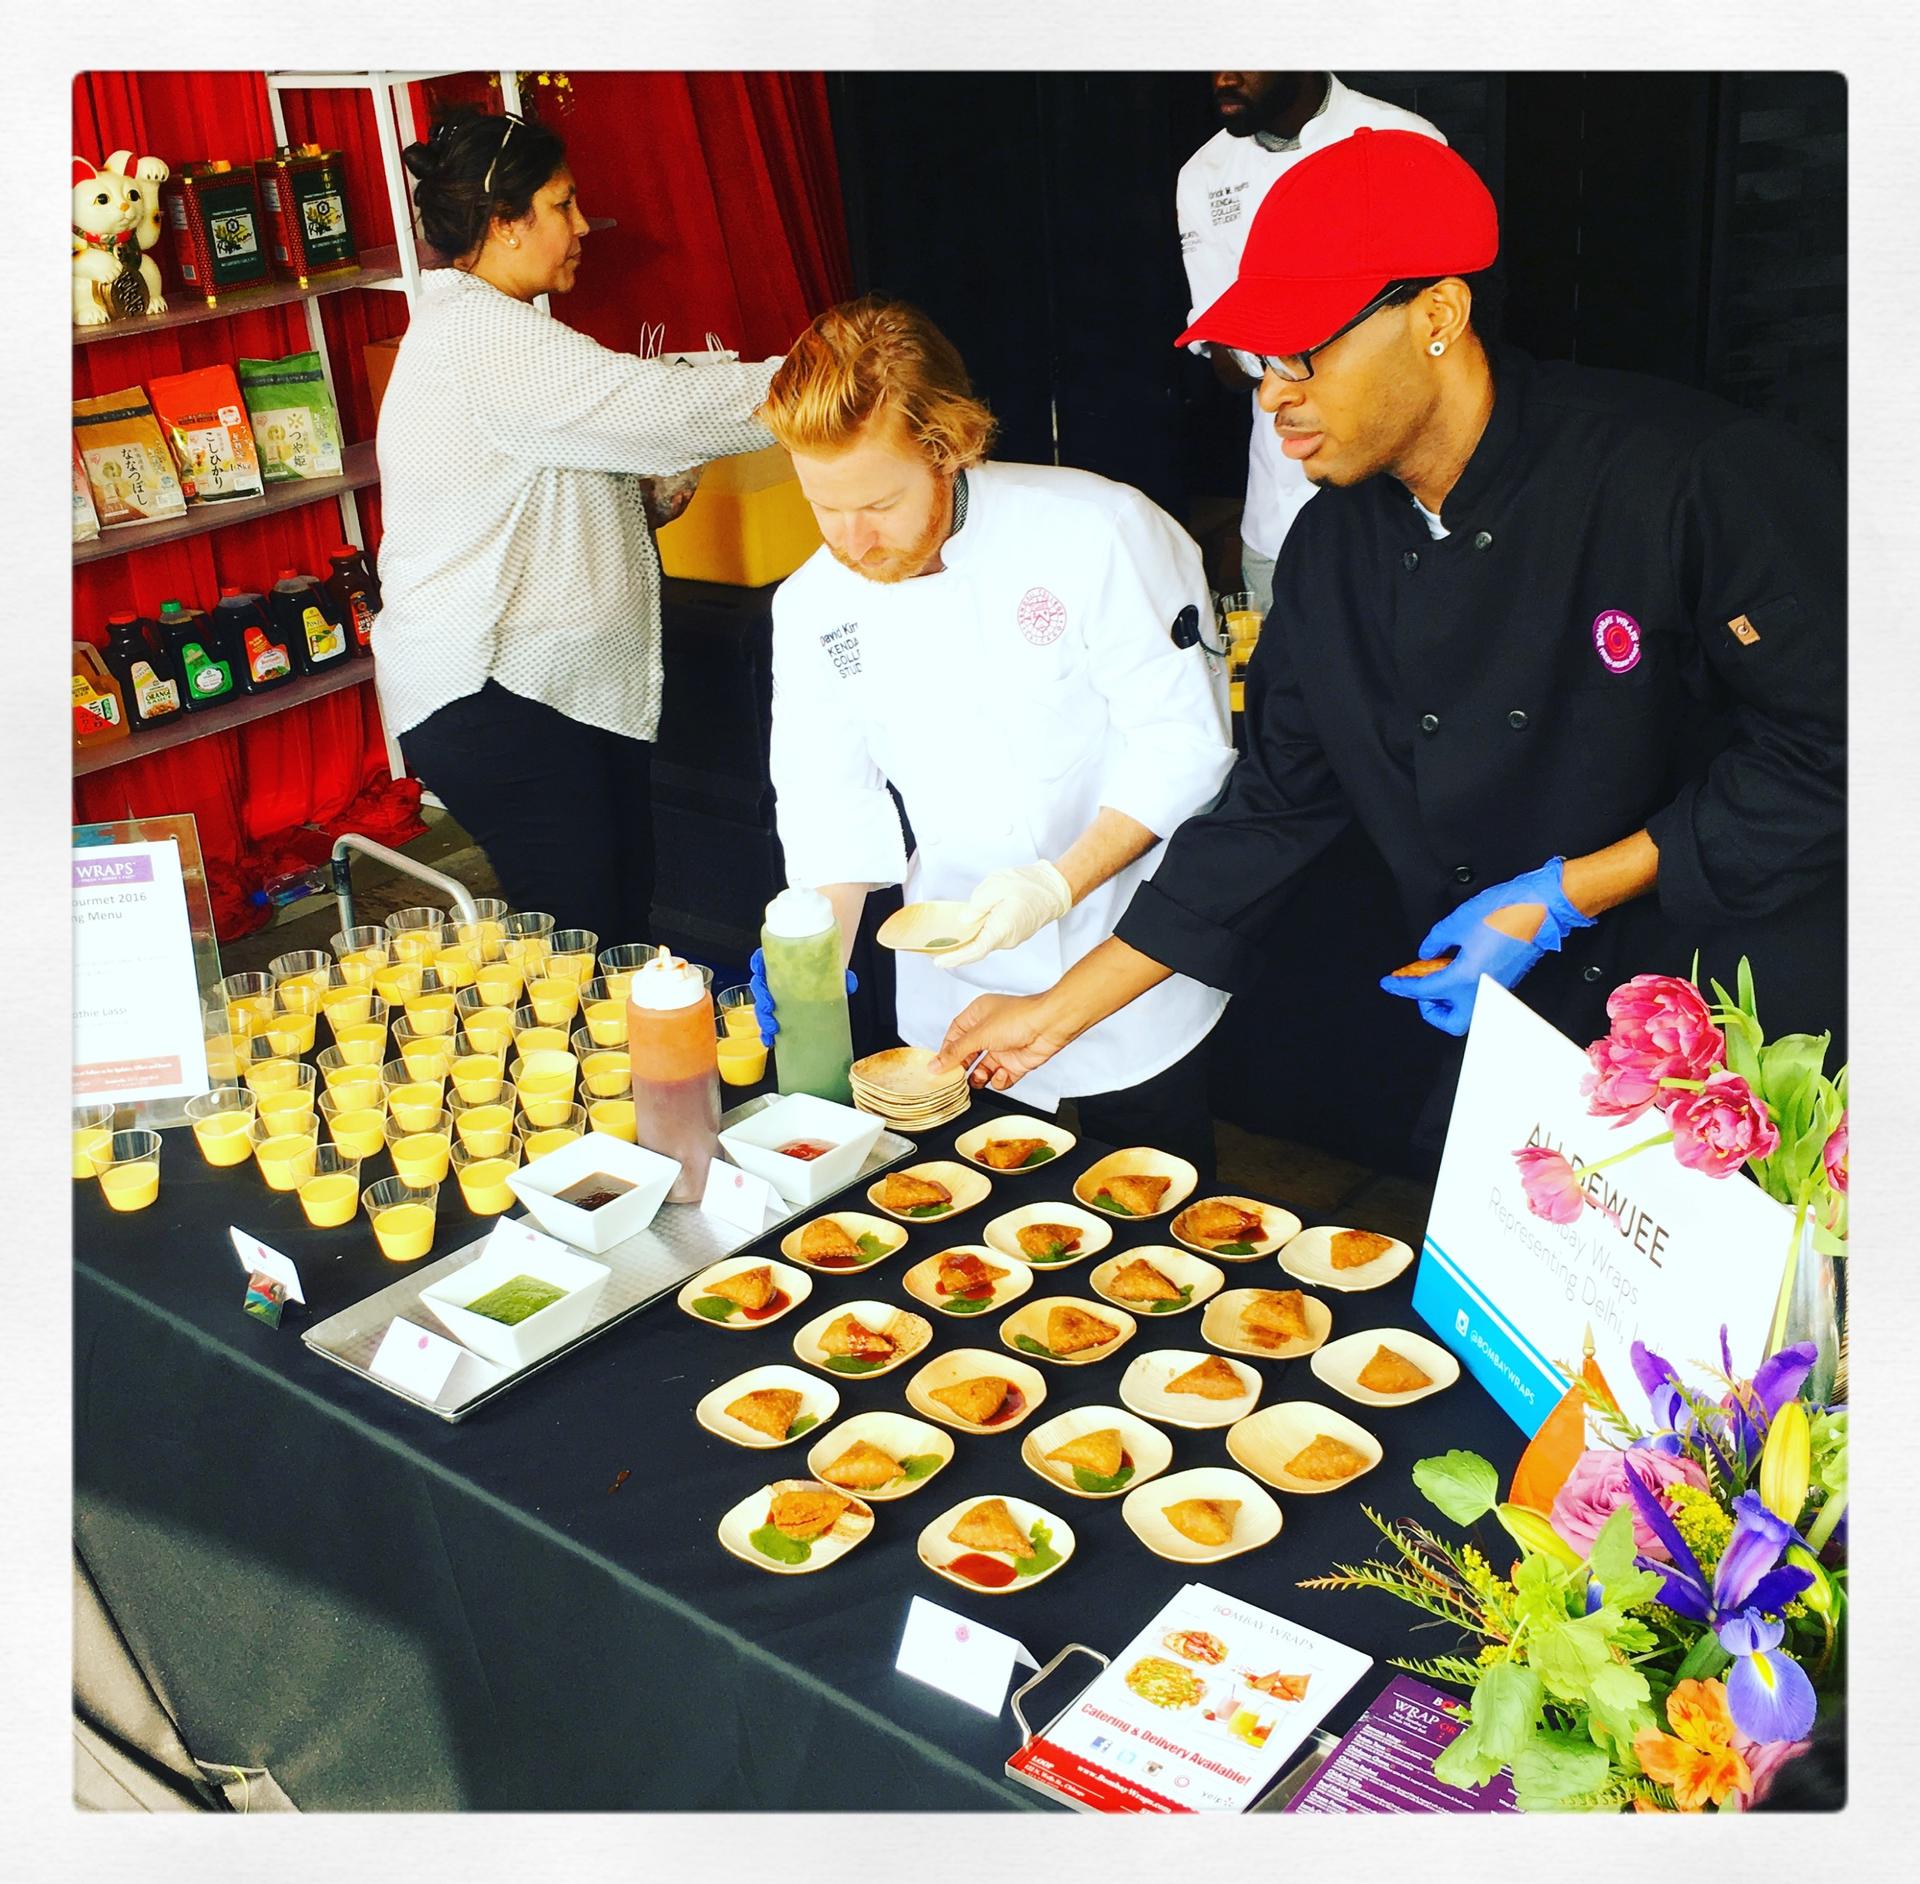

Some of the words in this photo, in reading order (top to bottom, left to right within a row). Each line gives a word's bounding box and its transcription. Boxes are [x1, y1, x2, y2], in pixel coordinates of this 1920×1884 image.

[1211, 203, 1241, 217] COLLEGE
[1212, 212, 1242, 226] STUDENT
[206, 431, 224, 489] こしひかり
[289, 431, 307, 467] つや姫
[121, 448, 148, 505] ななつぼし
[820, 627, 843, 647] David
[1596, 615, 1613, 647] BOMBAY
[1616, 615, 1639, 642] WRAPS
[75, 862, 134, 878] WRAPS
[118, 892, 148, 903] 2016
[88, 911, 122, 921] Menu
[1489, 1186, 1578, 1302] Representing
[1582, 1276, 1625, 1345] Delhi,
[1592, 1238, 1640, 1305] Wraps
[1470, 1329, 1535, 1405] @BOMBAYWRAPS
[1212, 1604, 1264, 1630] BOMBAY
[1270, 1626, 1315, 1649] WRAPS
[1395, 1699, 1440, 1725] WRAP
[1081, 1702, 1131, 1733] Catering
[1130, 1727, 1139, 1737] &
[1141, 1730, 1188, 1759] Delivery
[1189, 1752, 1253, 1787] Available!
[1031, 1755, 1055, 1770] LOOP
[1077, 1765, 1172, 1814] www.BombayWraps.com
